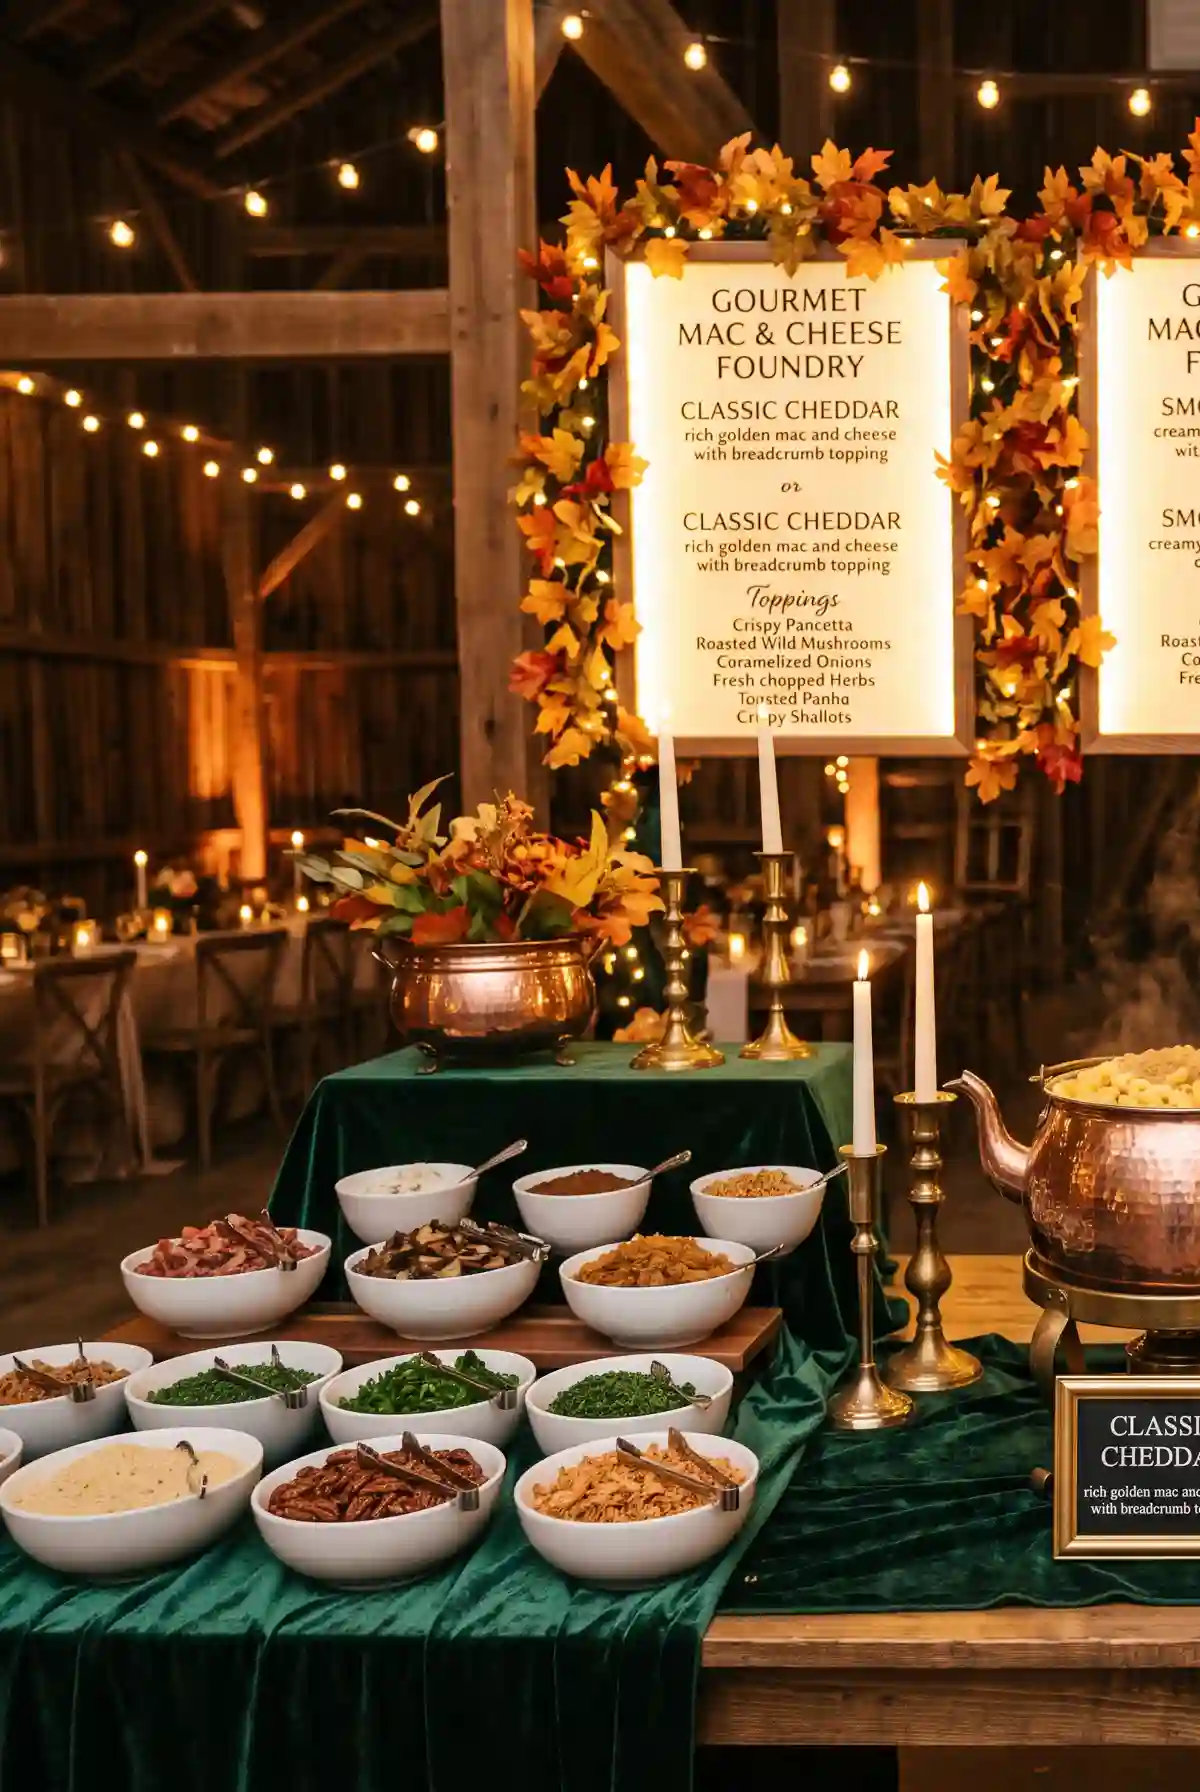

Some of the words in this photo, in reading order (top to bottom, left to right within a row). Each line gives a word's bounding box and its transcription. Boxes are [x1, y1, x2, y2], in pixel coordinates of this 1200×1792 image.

[712, 288, 866, 312] GOURMET
[680, 322, 745, 346] MAC
[756, 322, 775, 345] &
[786, 321, 901, 345] CHEESE
[718, 355, 864, 379] FOUNDRY
[681, 401, 777, 420] CLASSIC
[785, 400, 899, 419] CHEDDAR
[686, 428, 713, 441] rich
[718, 428, 770, 445] golden
[776, 431, 806, 441] mac
[812, 428, 839, 441] and
[844, 428, 896, 441] cheese
[695, 447, 726, 460] with
[732, 446, 824, 460] breadcrumb
[829, 446, 888, 464] topping
[781, 482, 802, 493] or
[684, 512, 779, 531] CLASSIC
[788, 512, 901, 530] CHEDDAR
[685, 540, 713, 552] rich
[719, 539, 771, 557] golden
[777, 543, 807, 552] mac
[813, 539, 840, 552] and
[845, 539, 898, 552] cheese
[697, 559, 729, 571] with
[734, 559, 826, 572] breadcrumb
[831, 559, 890, 575] topping
[747, 584, 840, 616] Toppings
[733, 618, 781, 635] Crispy
[787, 618, 853, 632] Pancetta
[697, 636, 756, 650] Roasted
[762, 636, 796, 650] Wild
[801, 636, 890, 650] Mushrooms
[817, 654, 871, 668] Onions
[714, 673, 754, 687] Fresh
[760, 673, 824, 691] chopped
[831, 673, 875, 687] Herbs
[737, 710, 786, 727] Cripy
[791, 709, 851, 723] Shallots
[1084, 1485, 1107, 1498] rich
[1154, 1489, 1178, 1497] mac
[1090, 1502, 1117, 1514] with
[1121, 1502, 1191, 1514] breadcrumb
